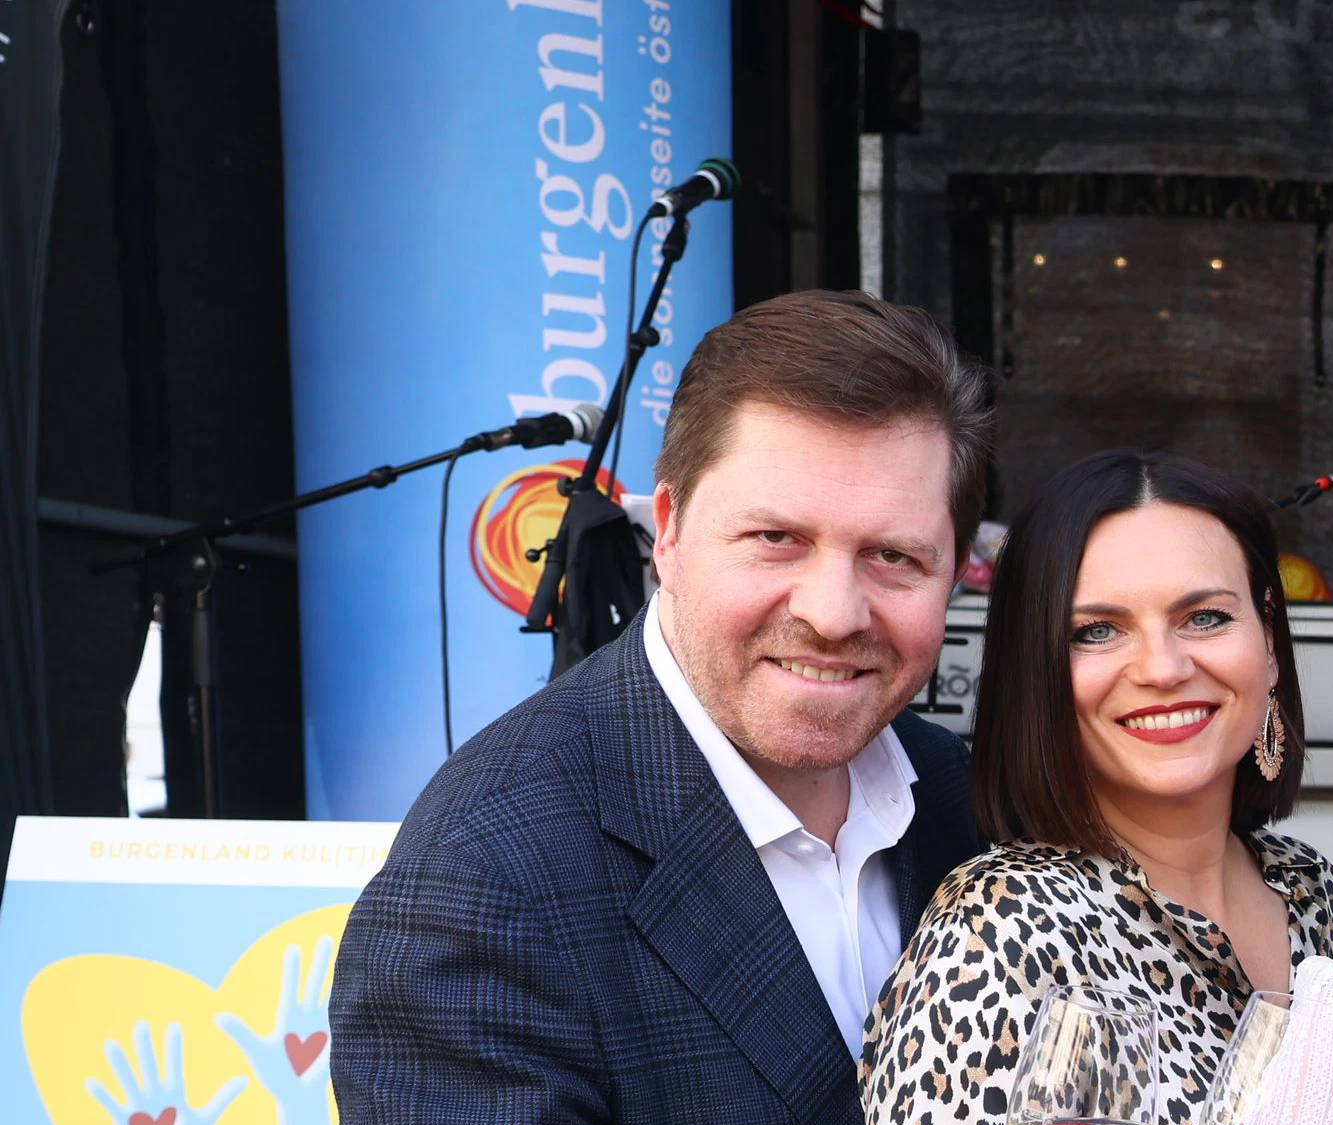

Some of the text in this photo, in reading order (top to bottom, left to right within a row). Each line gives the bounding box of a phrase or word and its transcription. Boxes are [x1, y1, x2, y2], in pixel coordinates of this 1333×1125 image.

[639, 77, 675, 347] soneseite
[641, 359, 674, 427] die
[88, 840, 271, 863] BURGENLAND
